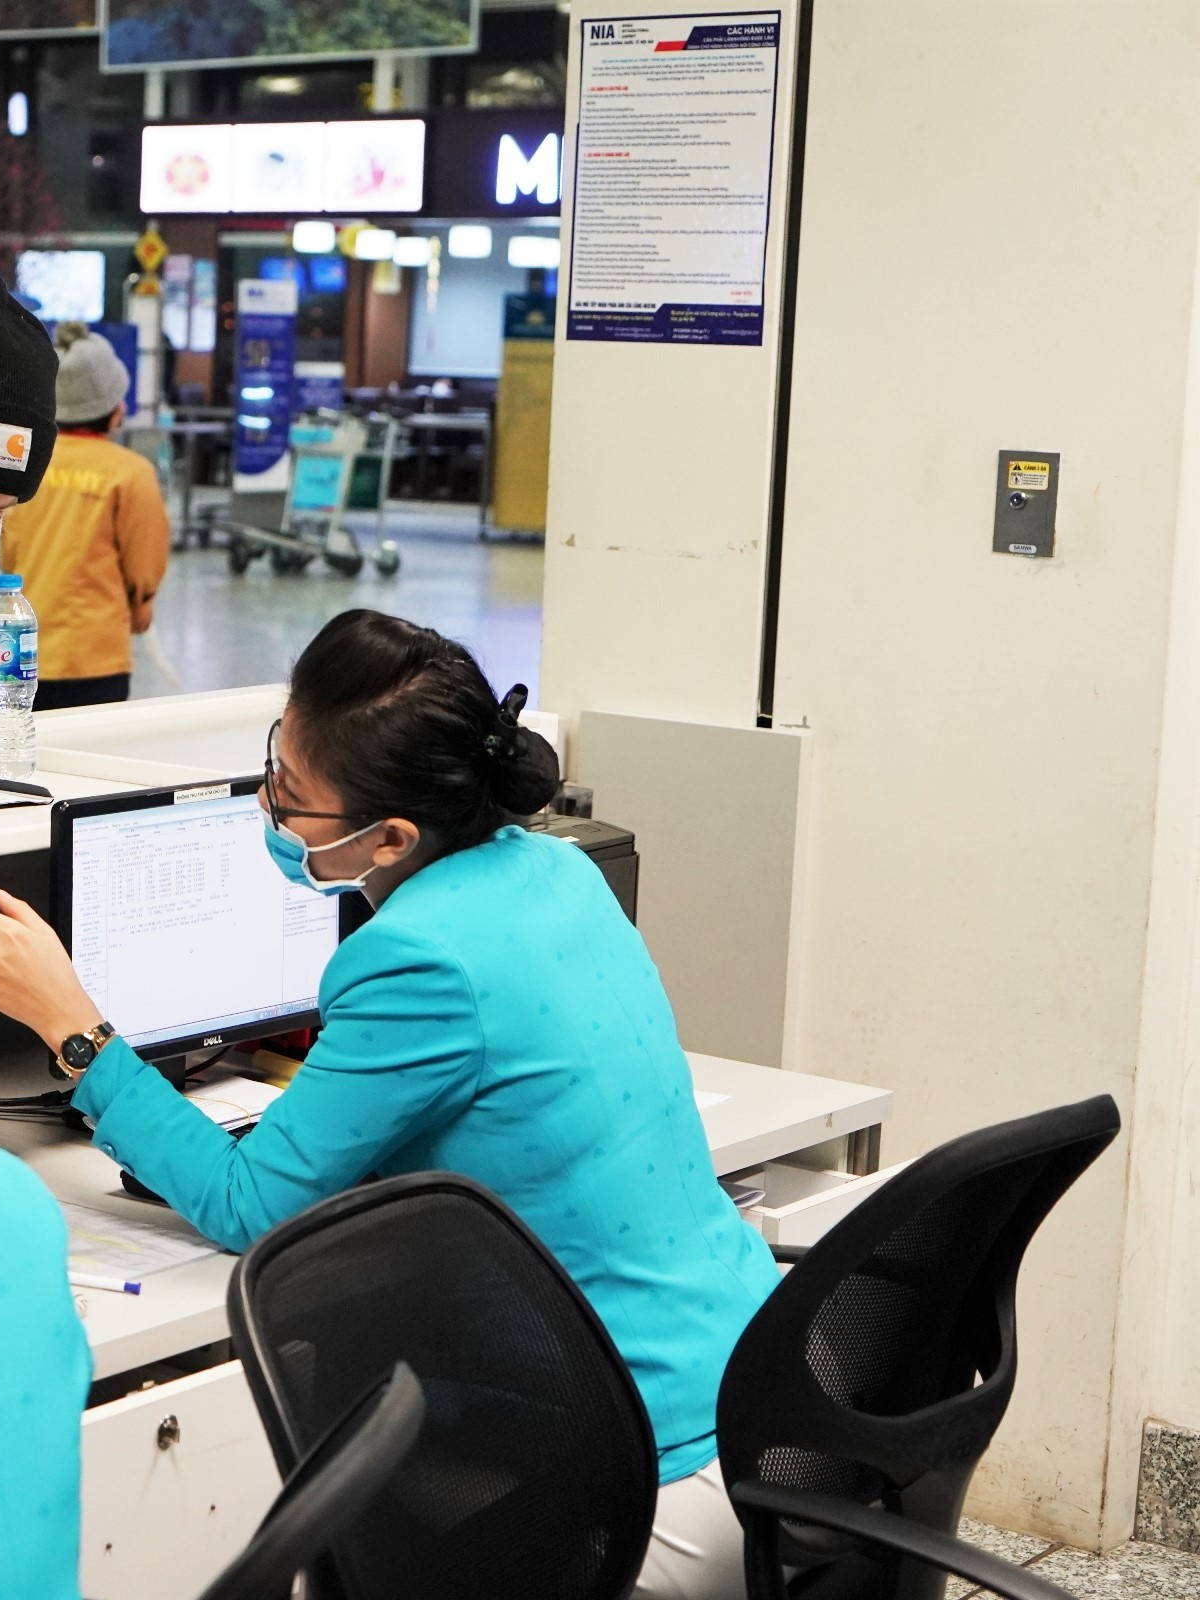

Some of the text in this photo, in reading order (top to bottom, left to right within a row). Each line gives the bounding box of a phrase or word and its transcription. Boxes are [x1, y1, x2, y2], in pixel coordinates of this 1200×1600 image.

[591, 24, 615, 40] NIA
[496, 132, 564, 204] M
[203, 1035, 223, 1047] DELL
